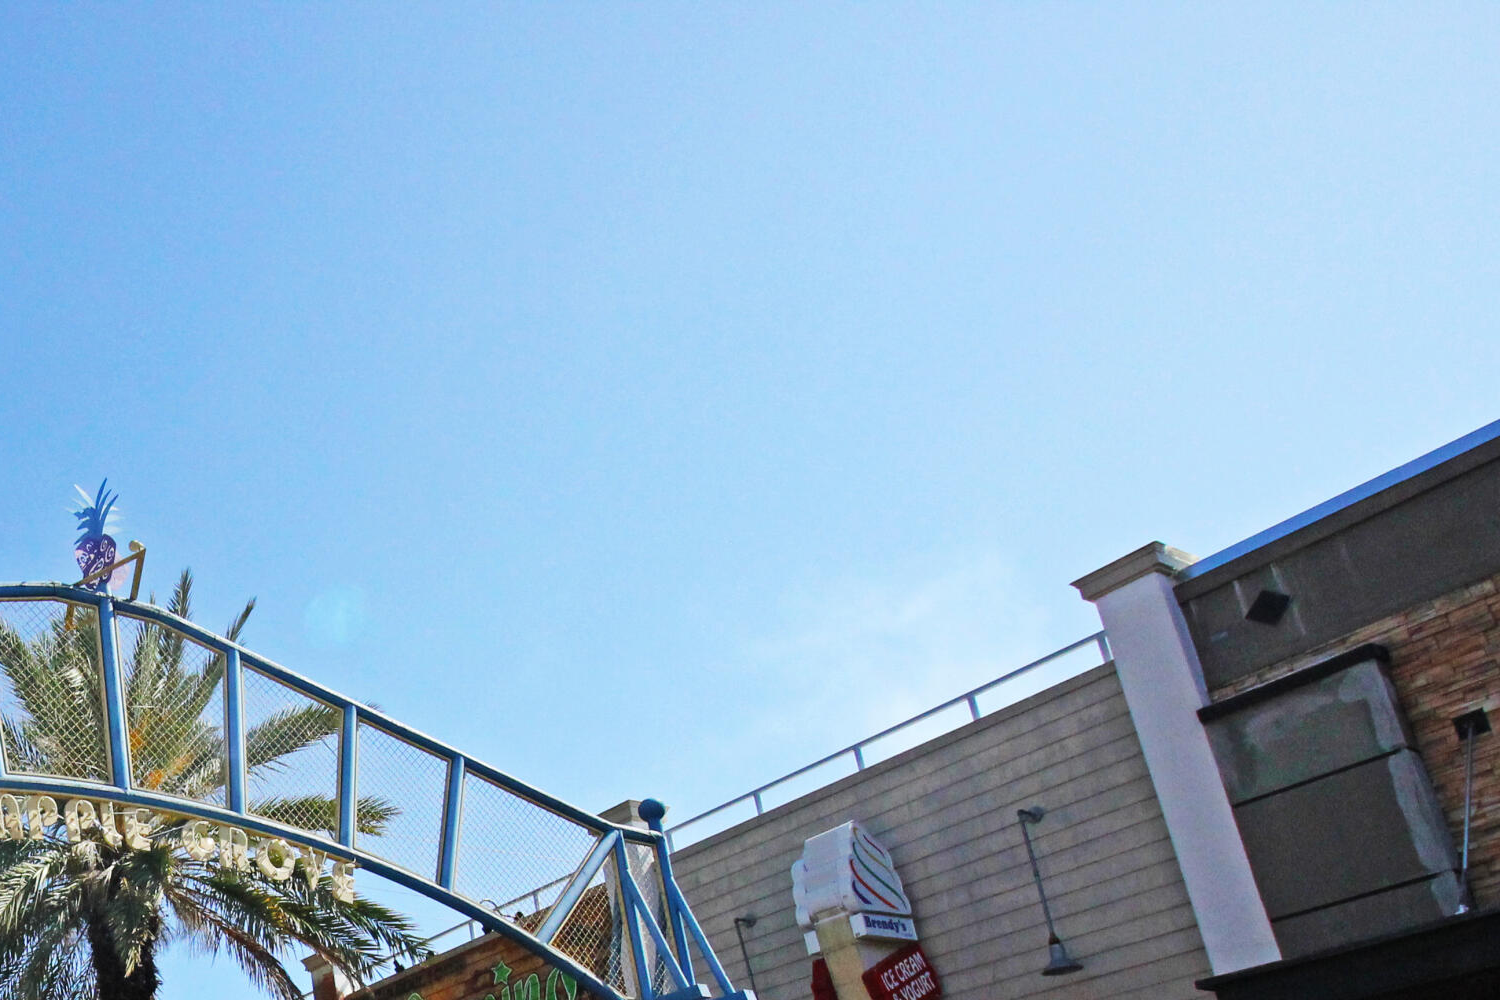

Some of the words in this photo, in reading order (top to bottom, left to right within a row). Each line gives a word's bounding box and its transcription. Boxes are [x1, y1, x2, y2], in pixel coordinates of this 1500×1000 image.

[863, 915, 907, 934] Brendy's
[880, 968, 900, 992] ICE
[894, 951, 927, 982] CREAM
